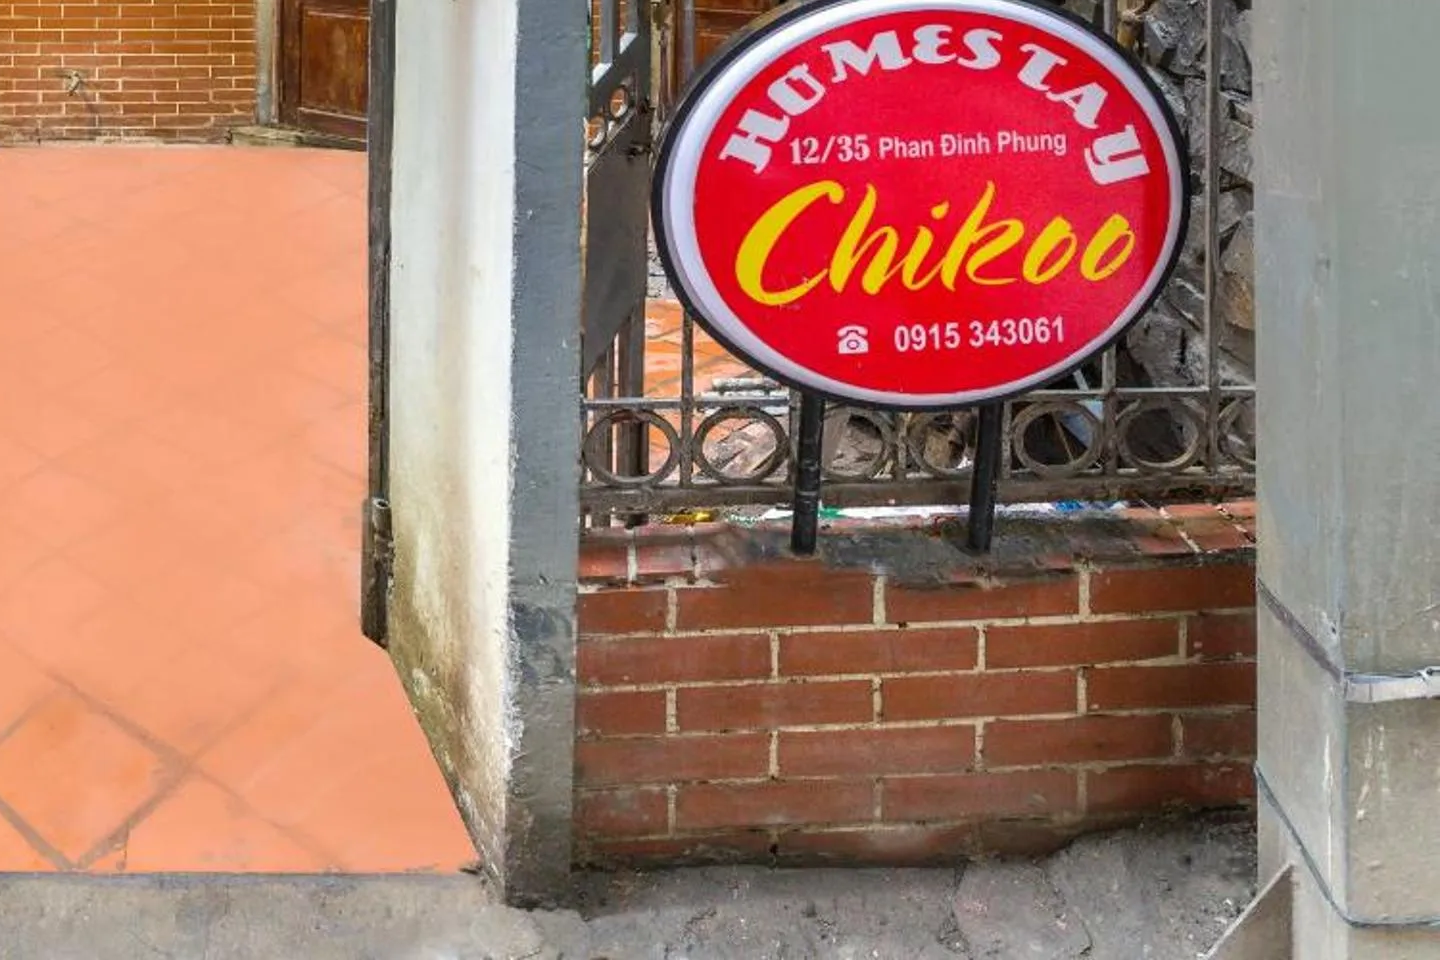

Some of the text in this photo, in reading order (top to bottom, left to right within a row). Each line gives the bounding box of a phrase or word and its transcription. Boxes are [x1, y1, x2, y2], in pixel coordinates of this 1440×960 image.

[719, 24, 1152, 186] HOMESTAY
[789, 134, 871, 165] 12/35
[879, 136, 934, 159] Phan
[997, 129, 1067, 156] Phung
[735, 180, 1136, 306] Chikoo
[893, 315, 1065, 352] 0915 343061
